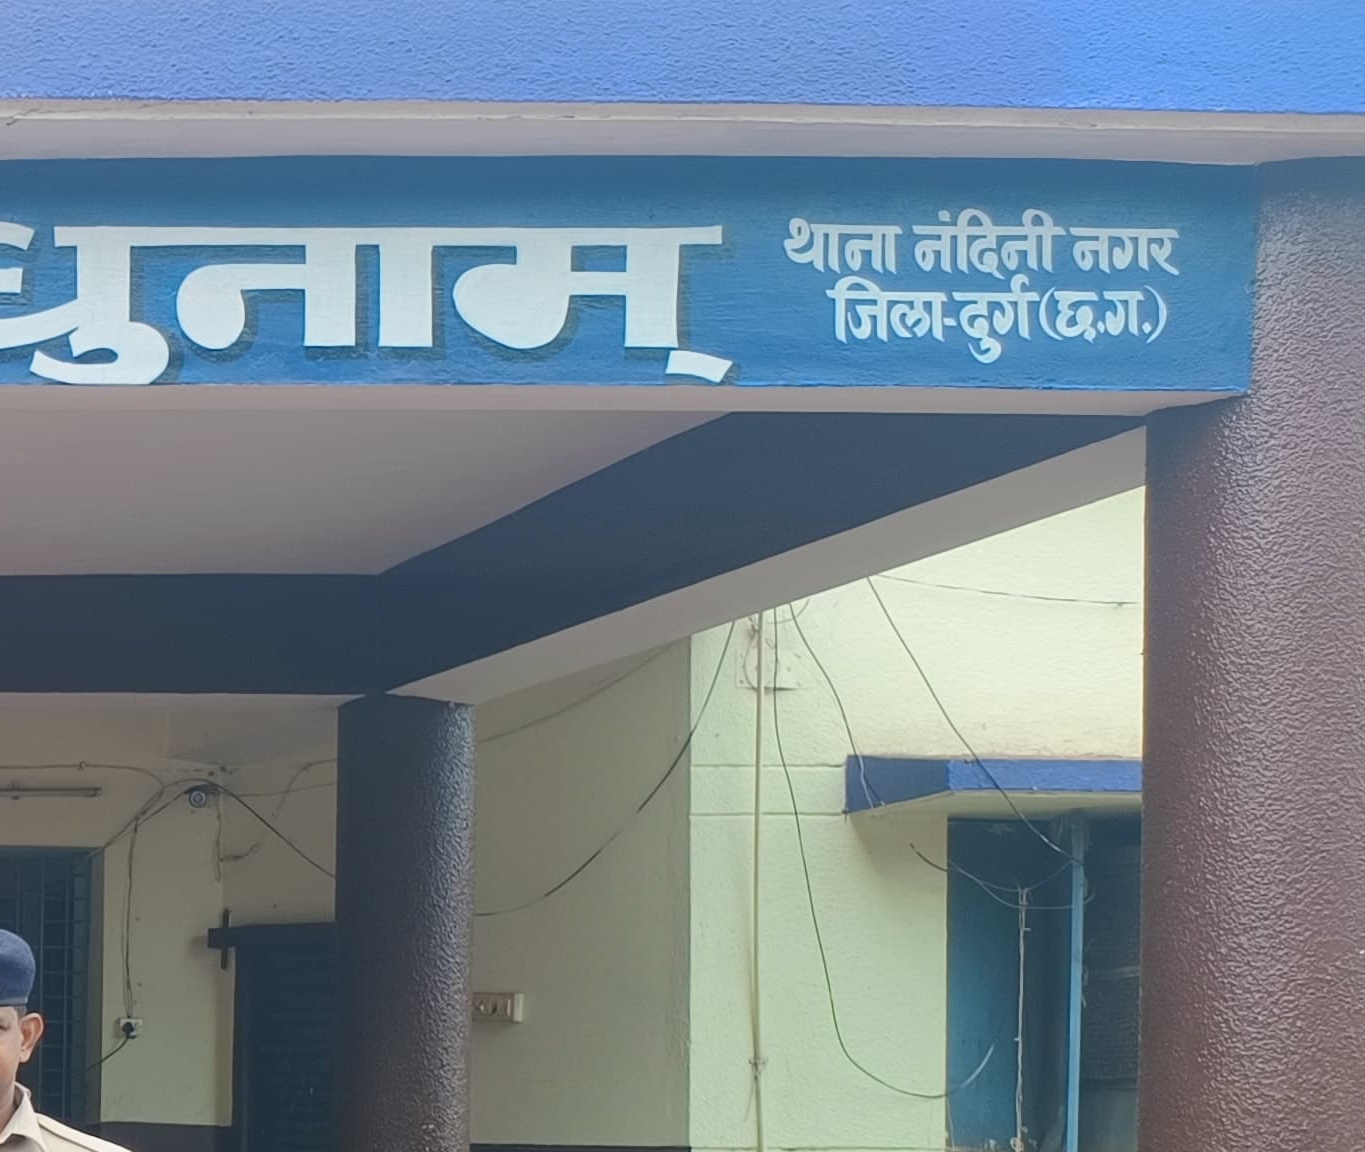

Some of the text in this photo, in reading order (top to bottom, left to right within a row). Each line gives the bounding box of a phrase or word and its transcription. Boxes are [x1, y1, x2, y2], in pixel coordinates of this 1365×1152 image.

[783, 208, 1180, 280] थाना नंदिनी नगर
